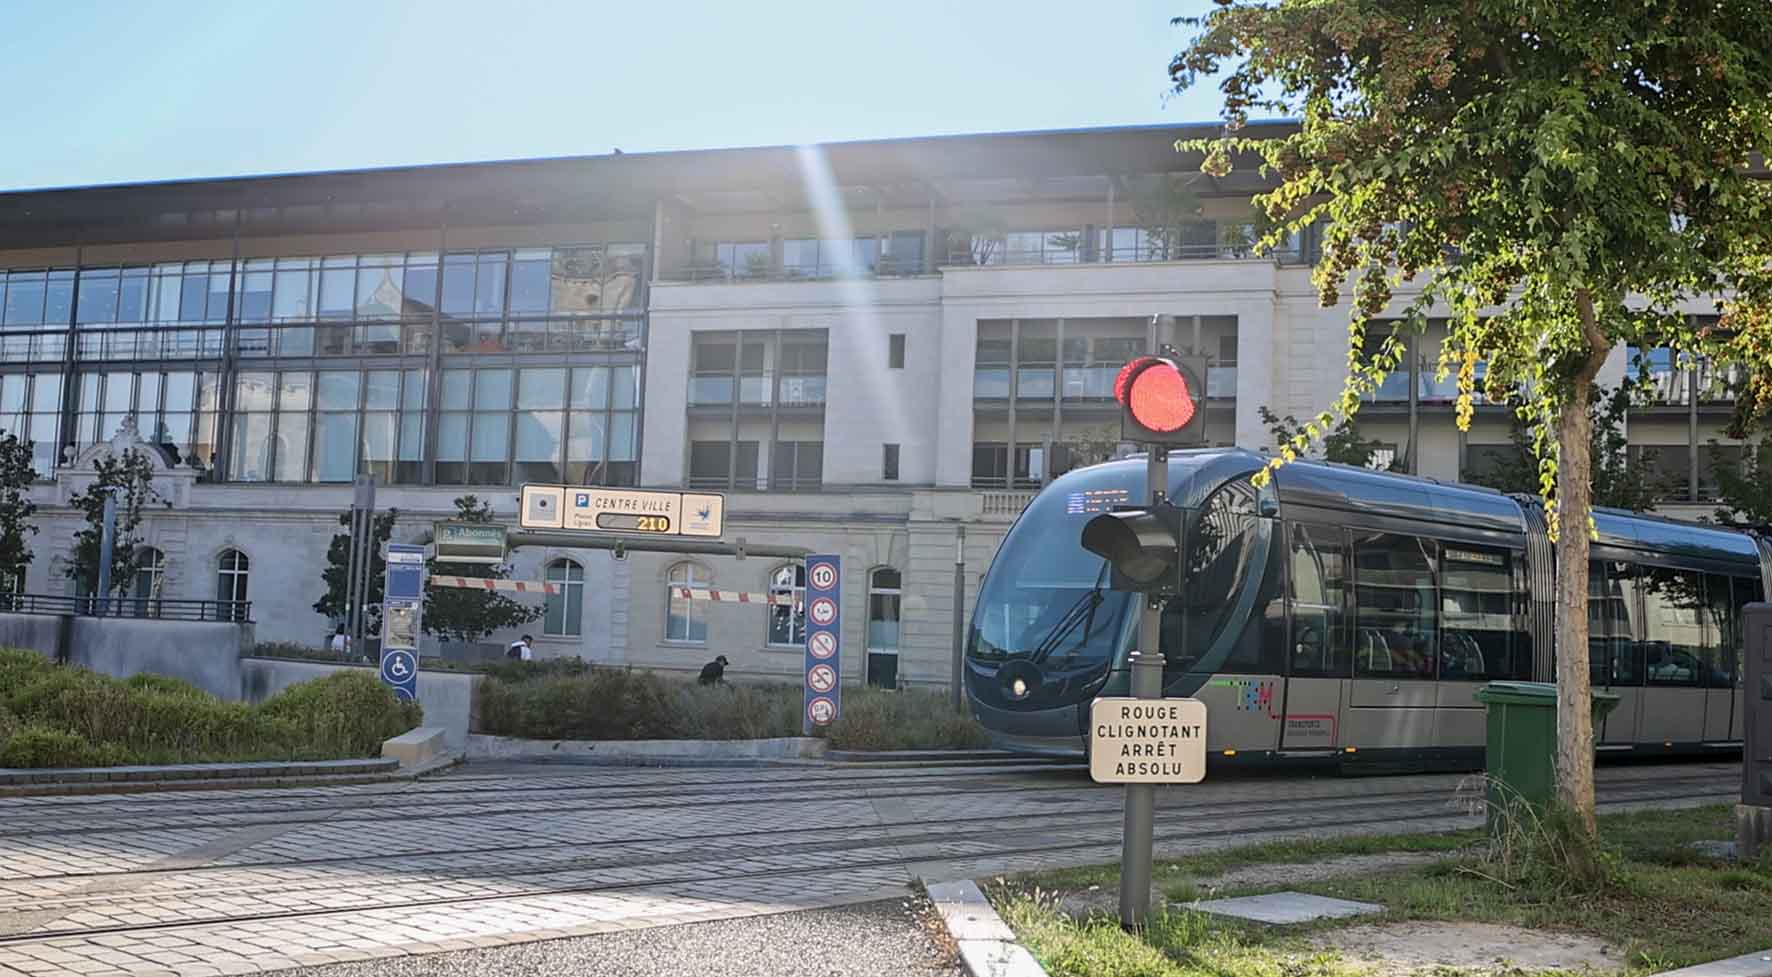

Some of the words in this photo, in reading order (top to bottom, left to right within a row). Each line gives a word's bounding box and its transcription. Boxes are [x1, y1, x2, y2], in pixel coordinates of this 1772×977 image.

[595, 498, 638, 510] CENTRE
[642, 499, 671, 511] VILLE
[638, 516, 668, 530] 210
[815, 570, 831, 583] 10
[1121, 706, 1177, 719] ROUGE
[1097, 725, 1200, 738] CLIGNOTANT
[1121, 741, 1177, 757] ARRÊT
[1115, 762, 1182, 775] ABSOLU
